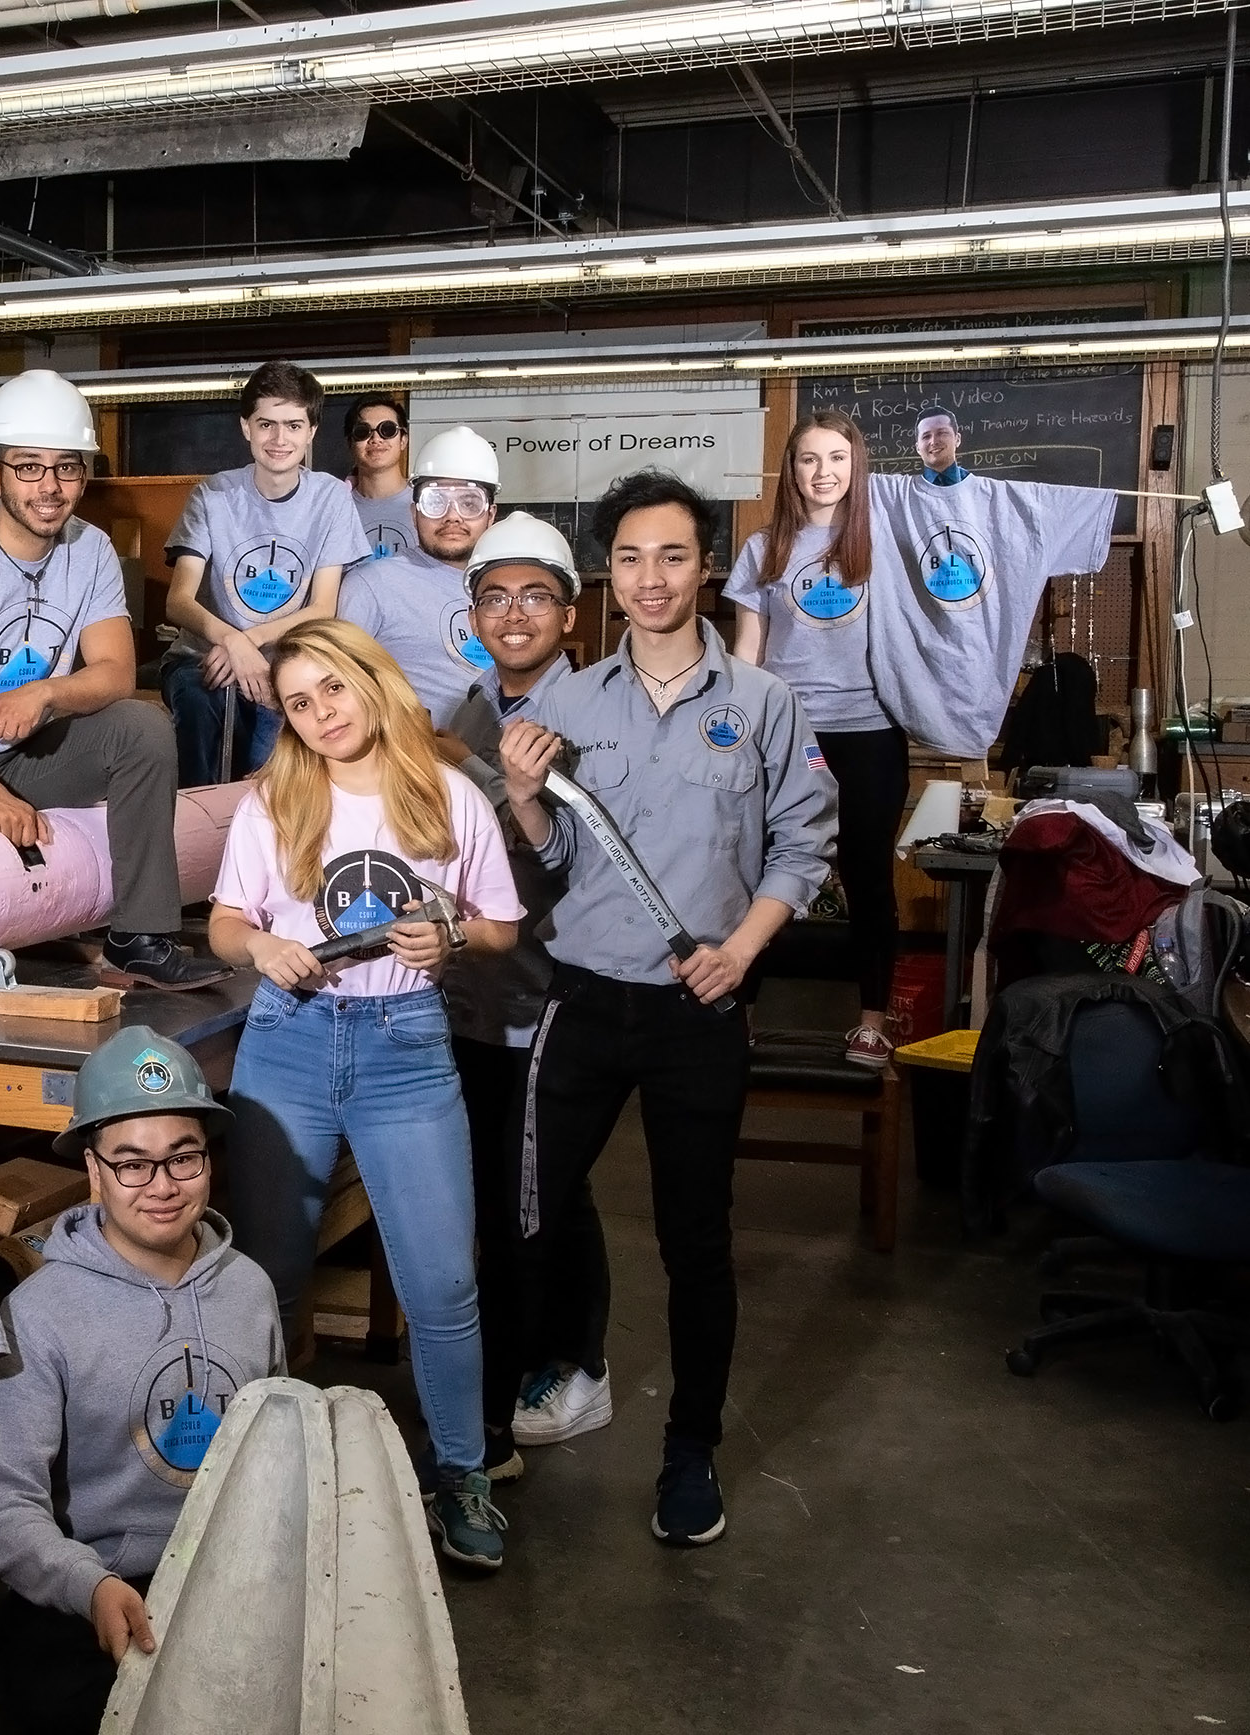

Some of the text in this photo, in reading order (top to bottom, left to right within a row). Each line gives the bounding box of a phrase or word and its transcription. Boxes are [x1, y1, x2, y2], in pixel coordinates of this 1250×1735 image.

[907, 321, 947, 333] Safety
[872, 393, 941, 417] Rocket
[952, 387, 1004, 407] Video
[981, 417, 1029, 432] Training
[1036, 413, 1067, 427] Fire
[1071, 407, 1133, 424] Hazards
[505, 436, 581, 453] Power
[589, 434, 612, 451] of
[619, 433, 716, 450] Dreams
[973, 451, 1037, 467] DUE ON
[597, 740, 619, 751] K. Ly
[585, 812, 670, 931] THE STUDENT MOTIVATOR
[181, 1420, 201, 1431] CSULB
[180, 1435, 206, 1446] LAUNCH
